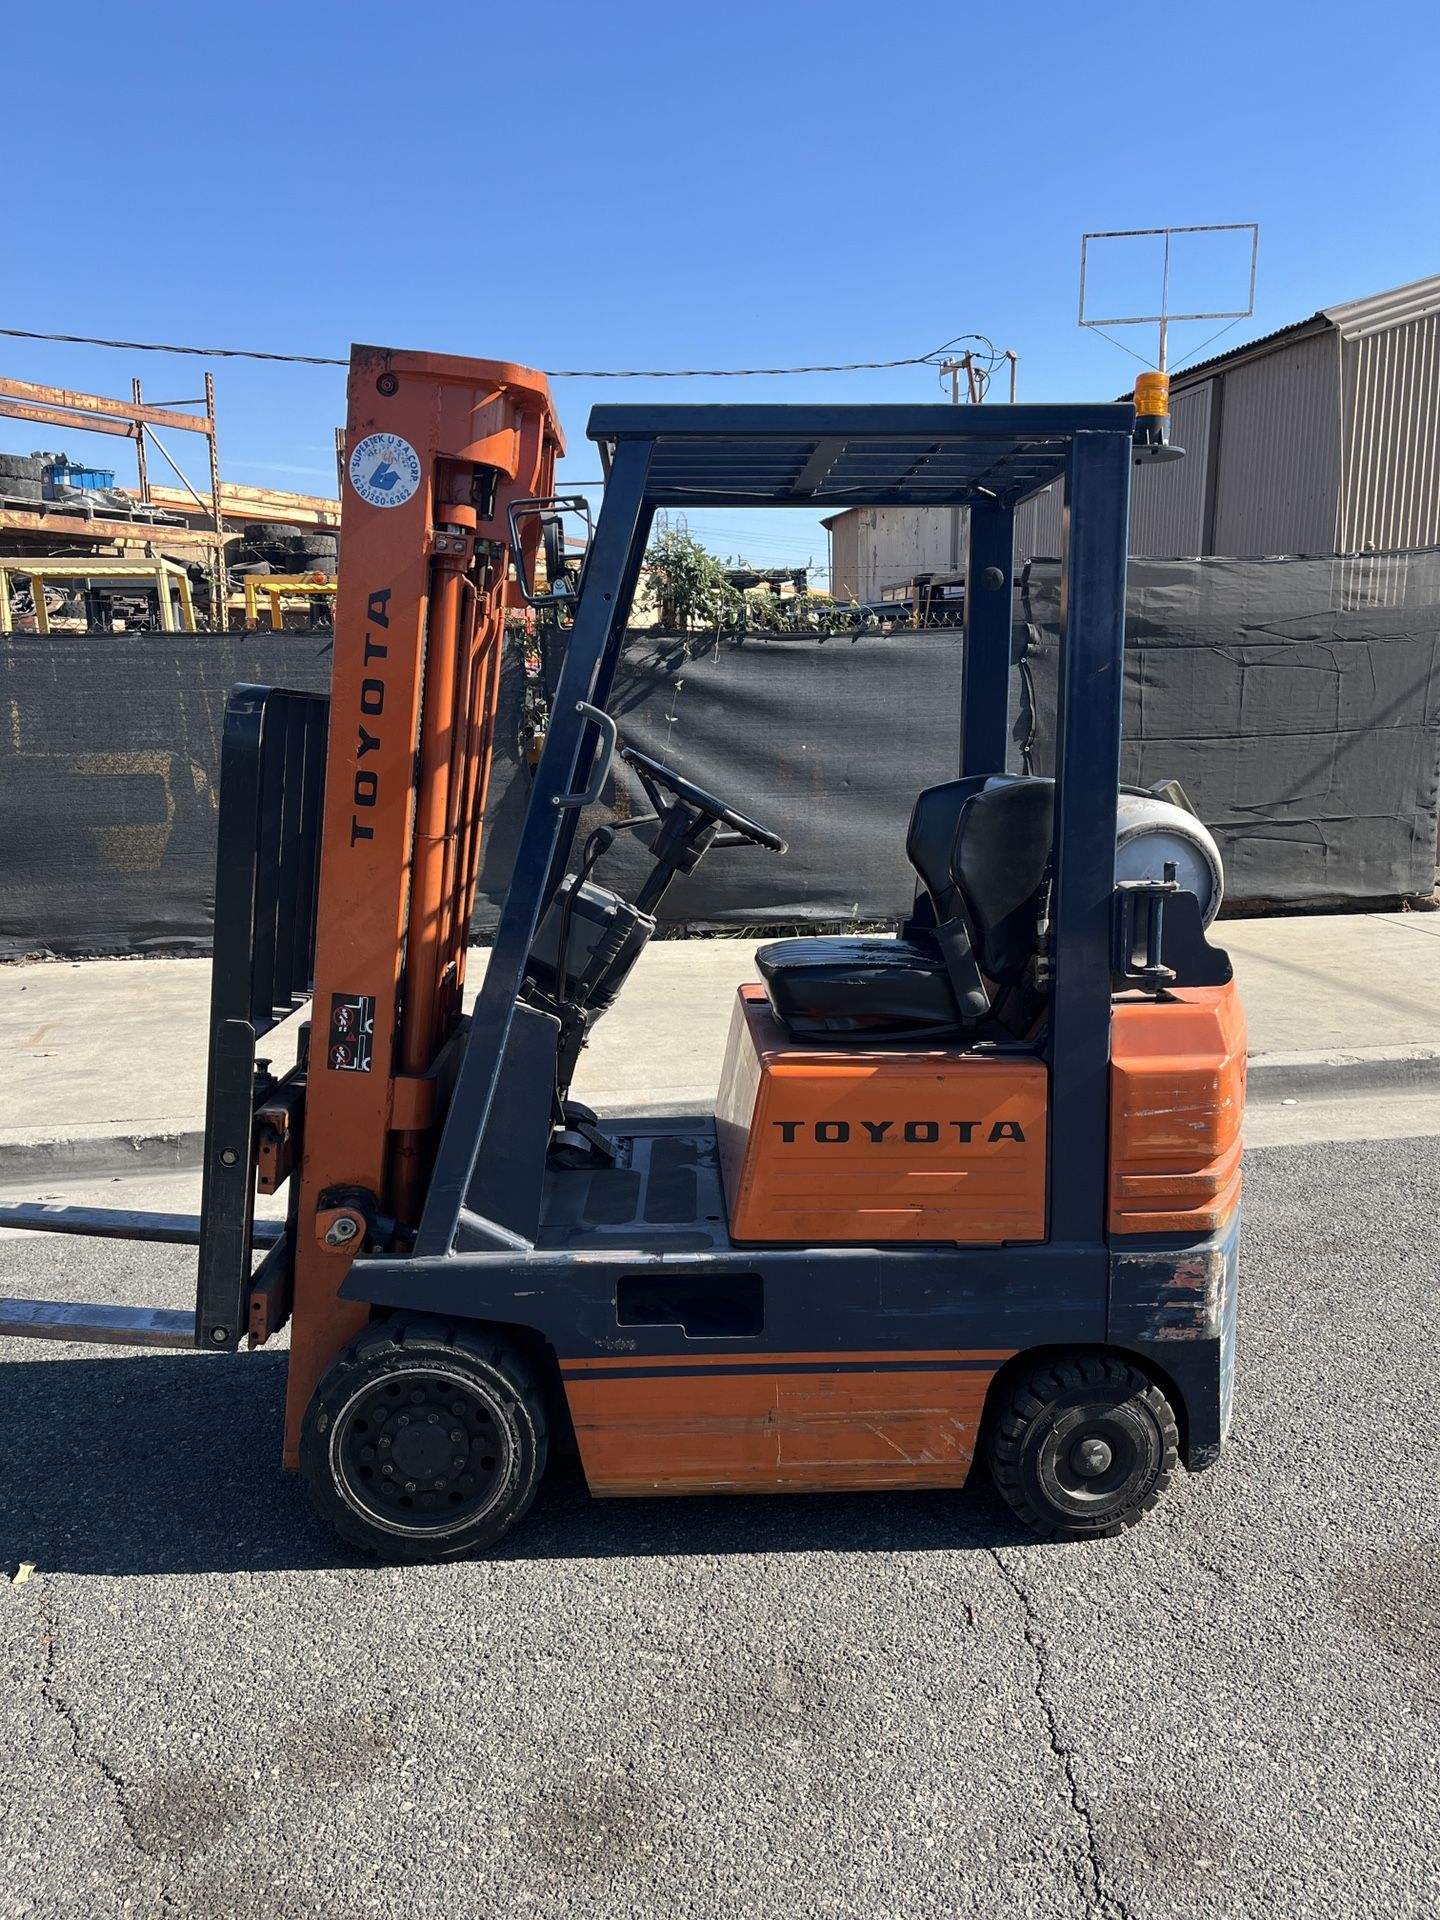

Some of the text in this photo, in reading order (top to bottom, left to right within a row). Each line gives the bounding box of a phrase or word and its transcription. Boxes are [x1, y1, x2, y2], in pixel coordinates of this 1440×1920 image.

[352, 435, 385, 468] SUPERTEK
[352, 474, 411, 505] (626)350-6362
[351, 588, 391, 848] TOYOTA
[772, 1121, 1026, 1143] TOYOTA
